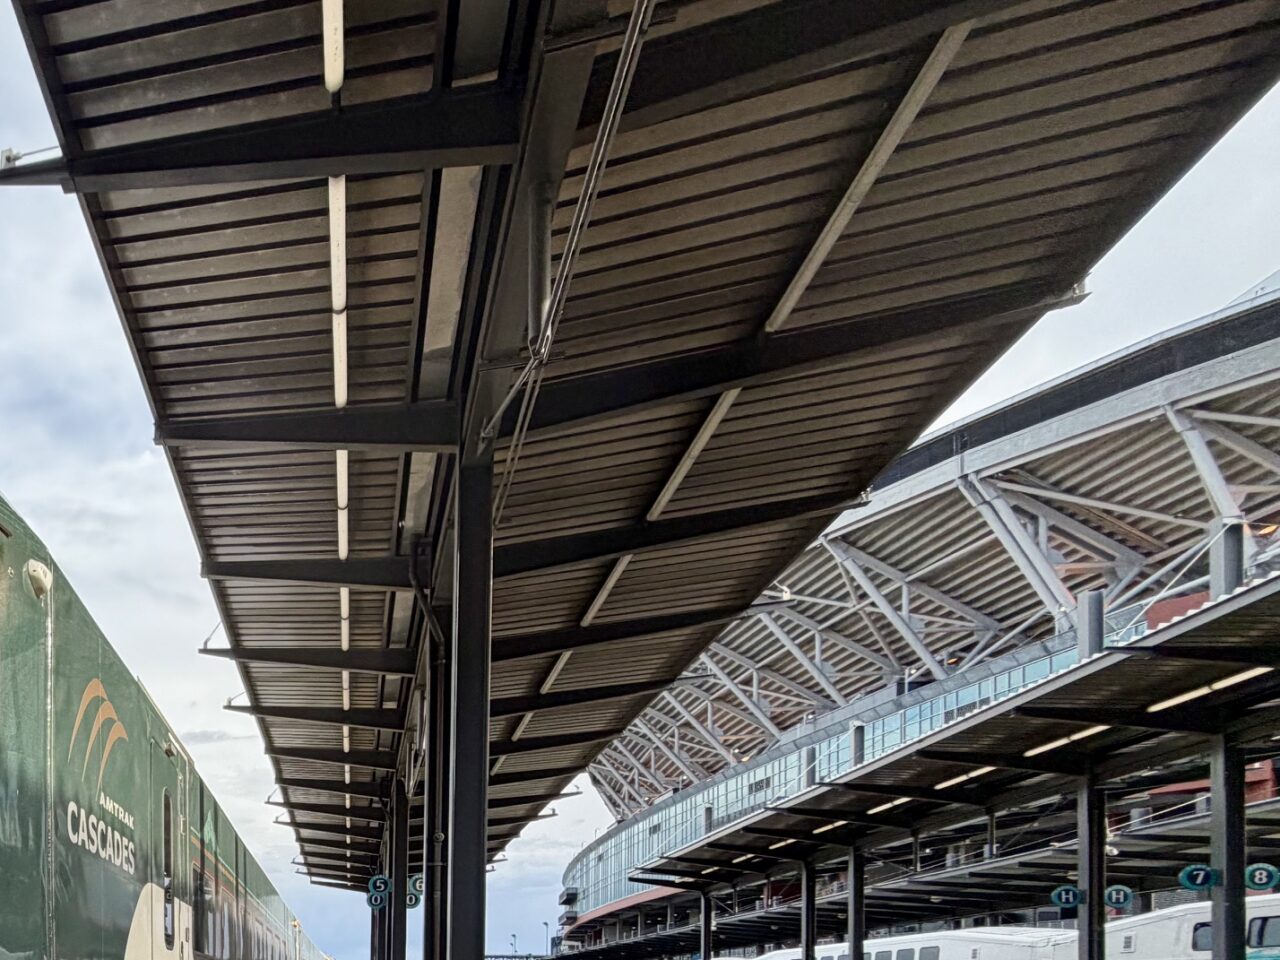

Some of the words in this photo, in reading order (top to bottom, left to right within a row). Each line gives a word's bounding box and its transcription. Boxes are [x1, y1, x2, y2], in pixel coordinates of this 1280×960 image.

[99, 791, 135, 830] AMTRAK
[67, 800, 135, 875] CASCADES
[1192, 870, 1206, 884] 7
[1253, 869, 1268, 884] 8
[376, 880, 385, 891] 5
[416, 880, 424, 891] 6
[1061, 891, 1073, 903] H
[1111, 890, 1124, 903] H
